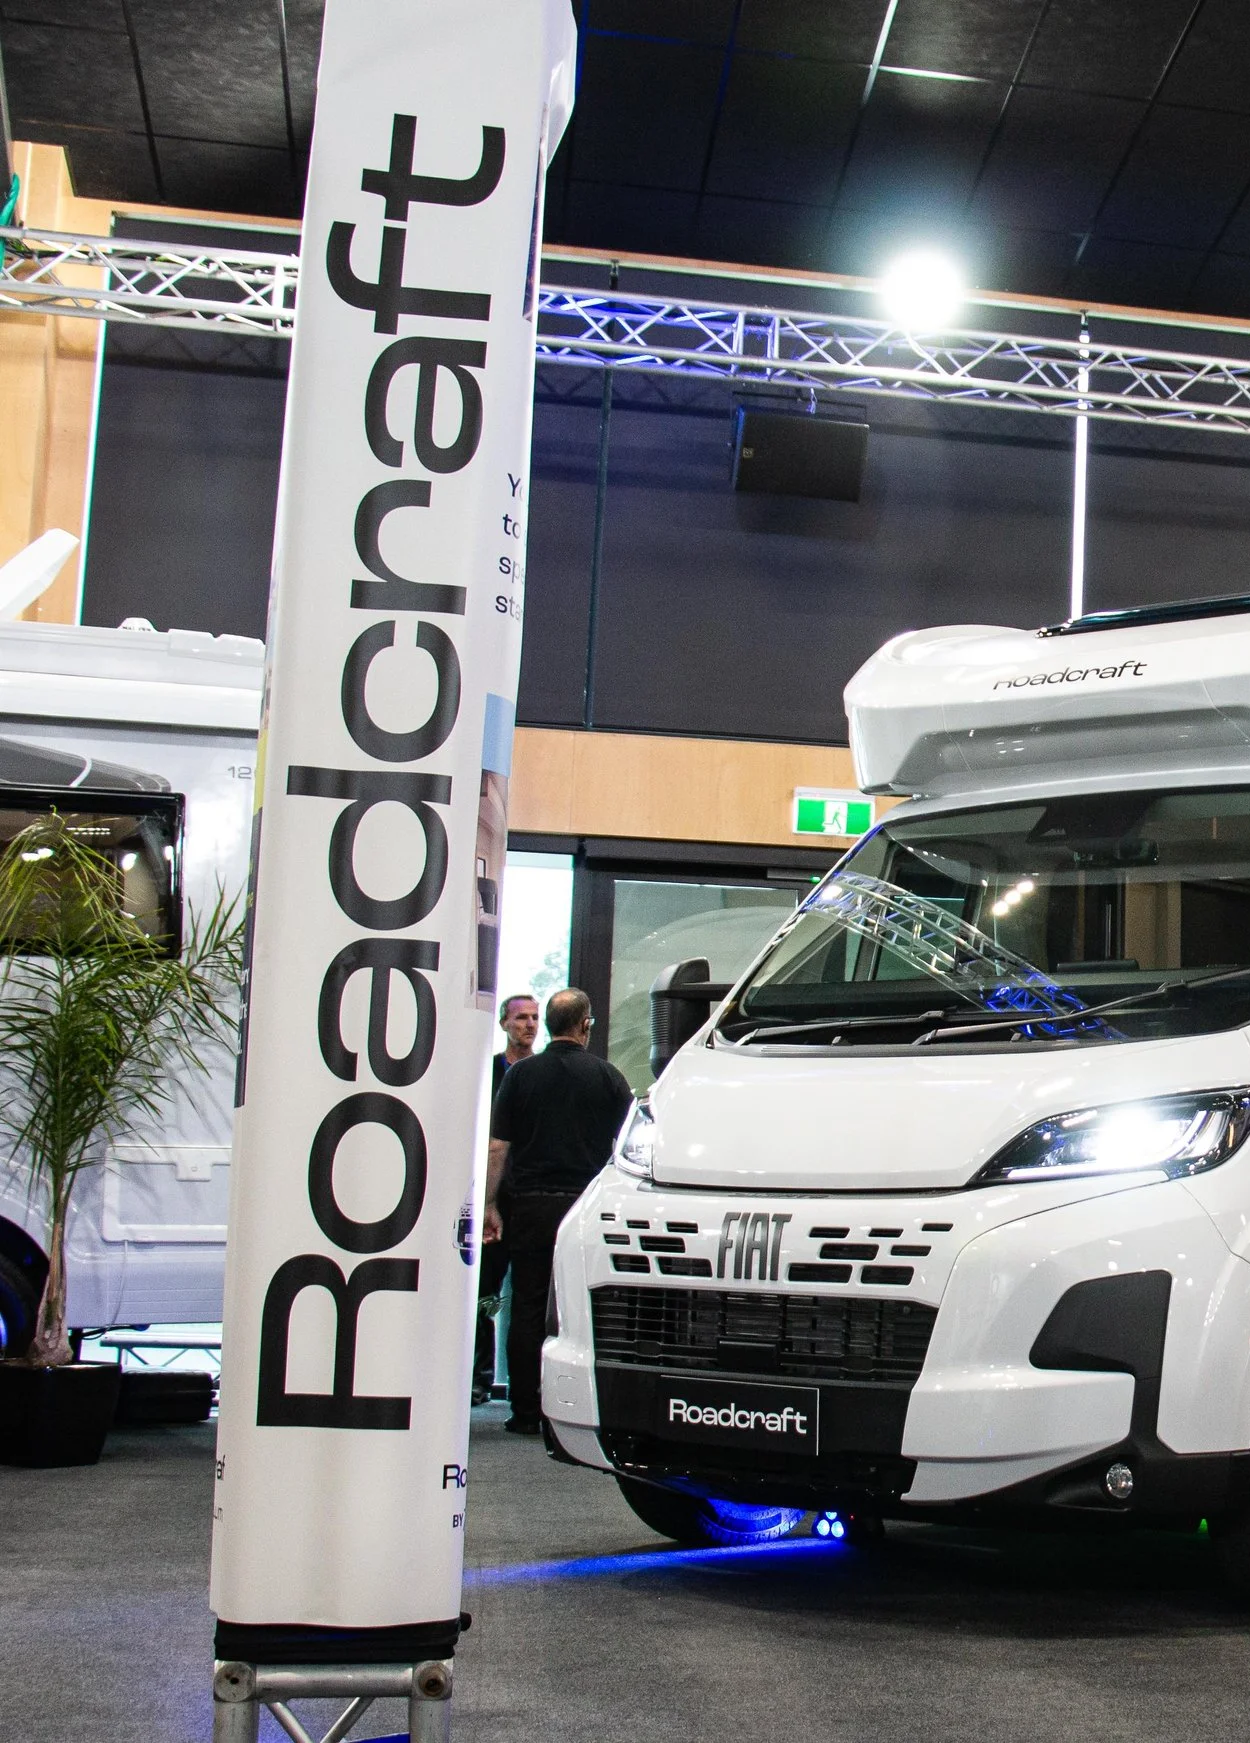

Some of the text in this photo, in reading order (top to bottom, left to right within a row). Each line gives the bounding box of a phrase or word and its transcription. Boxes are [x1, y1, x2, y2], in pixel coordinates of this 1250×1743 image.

[227, 765, 256, 780] 12
[256, 113, 505, 1430] Roadcraft
[716, 1212, 793, 1281] FIAT
[668, 1398, 808, 1435] Roadcraft
